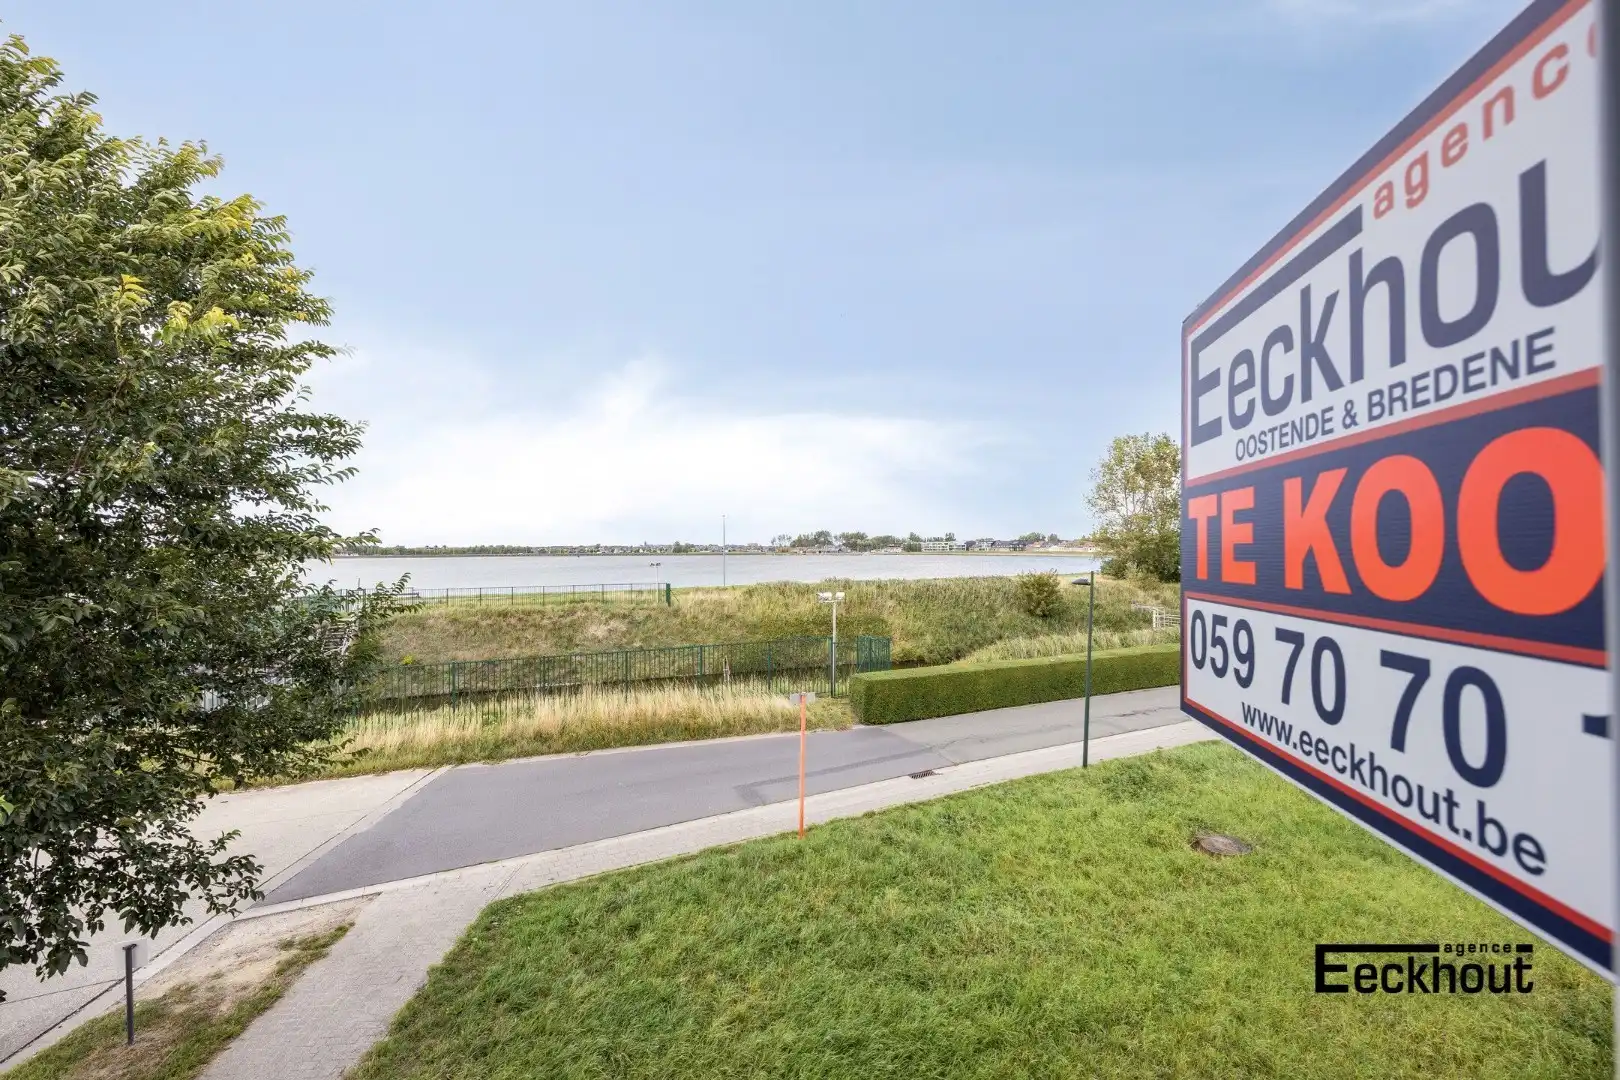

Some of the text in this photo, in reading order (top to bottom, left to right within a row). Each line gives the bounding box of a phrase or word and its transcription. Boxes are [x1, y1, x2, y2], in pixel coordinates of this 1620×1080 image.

[1372, 22, 1598, 219] agenc
[1235, 326, 1556, 461] OOSTENDE & BREDENE
[1188, 426, 1607, 616] TE KOO
[1191, 609, 1507, 789] 059 70 70
[1241, 701, 1547, 877] www.eeckhout.be
